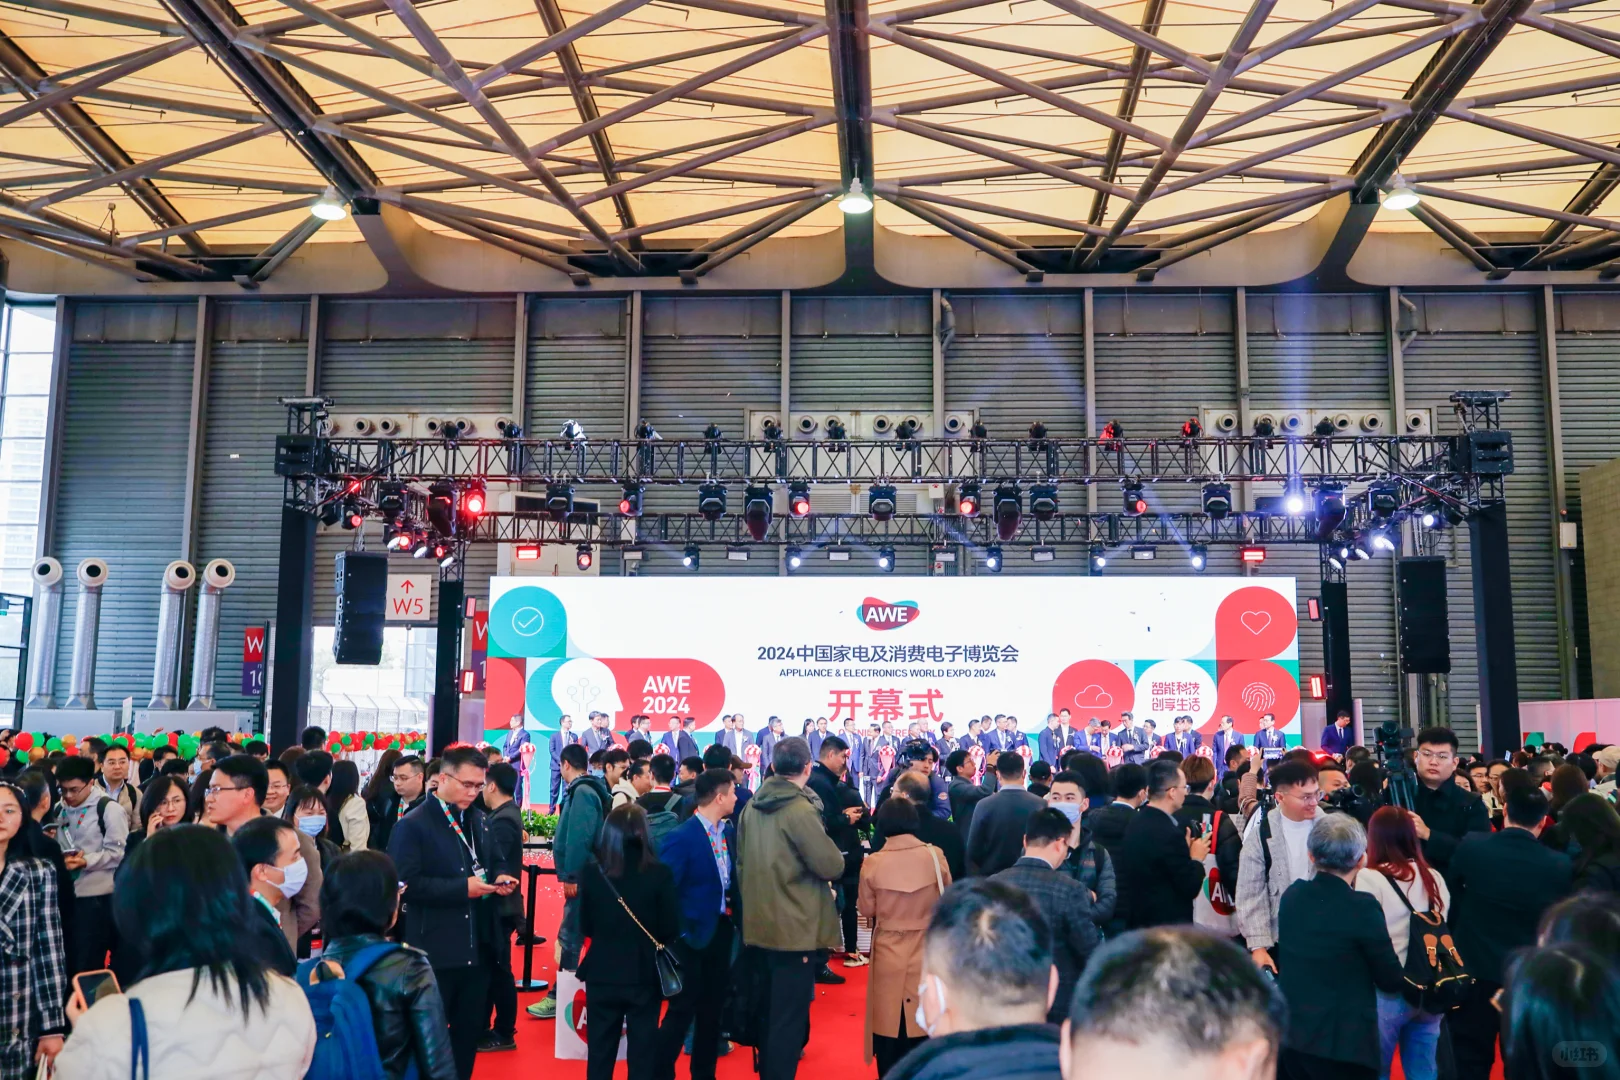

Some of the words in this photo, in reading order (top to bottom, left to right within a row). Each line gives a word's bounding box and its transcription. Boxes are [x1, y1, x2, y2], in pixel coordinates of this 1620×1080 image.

[393, 598, 424, 615] W5
[865, 606, 908, 623] AWE
[757, 644, 1019, 662] 2024中国家电及消费电子博览会
[779, 668, 833, 677] APPLIANCE
[835, 668, 842, 677] &
[844, 668, 908, 678] ELECTRONICS
[910, 668, 945, 678] WORLD
[946, 668, 972, 678] EXPO
[974, 668, 996, 678] 2024
[642, 675, 691, 694] AWE
[1152, 681, 1200, 696] 智能科技
[642, 696, 691, 714] 2024
[828, 688, 944, 723] 开幕式
[1152, 697, 1201, 712] 创享生活
